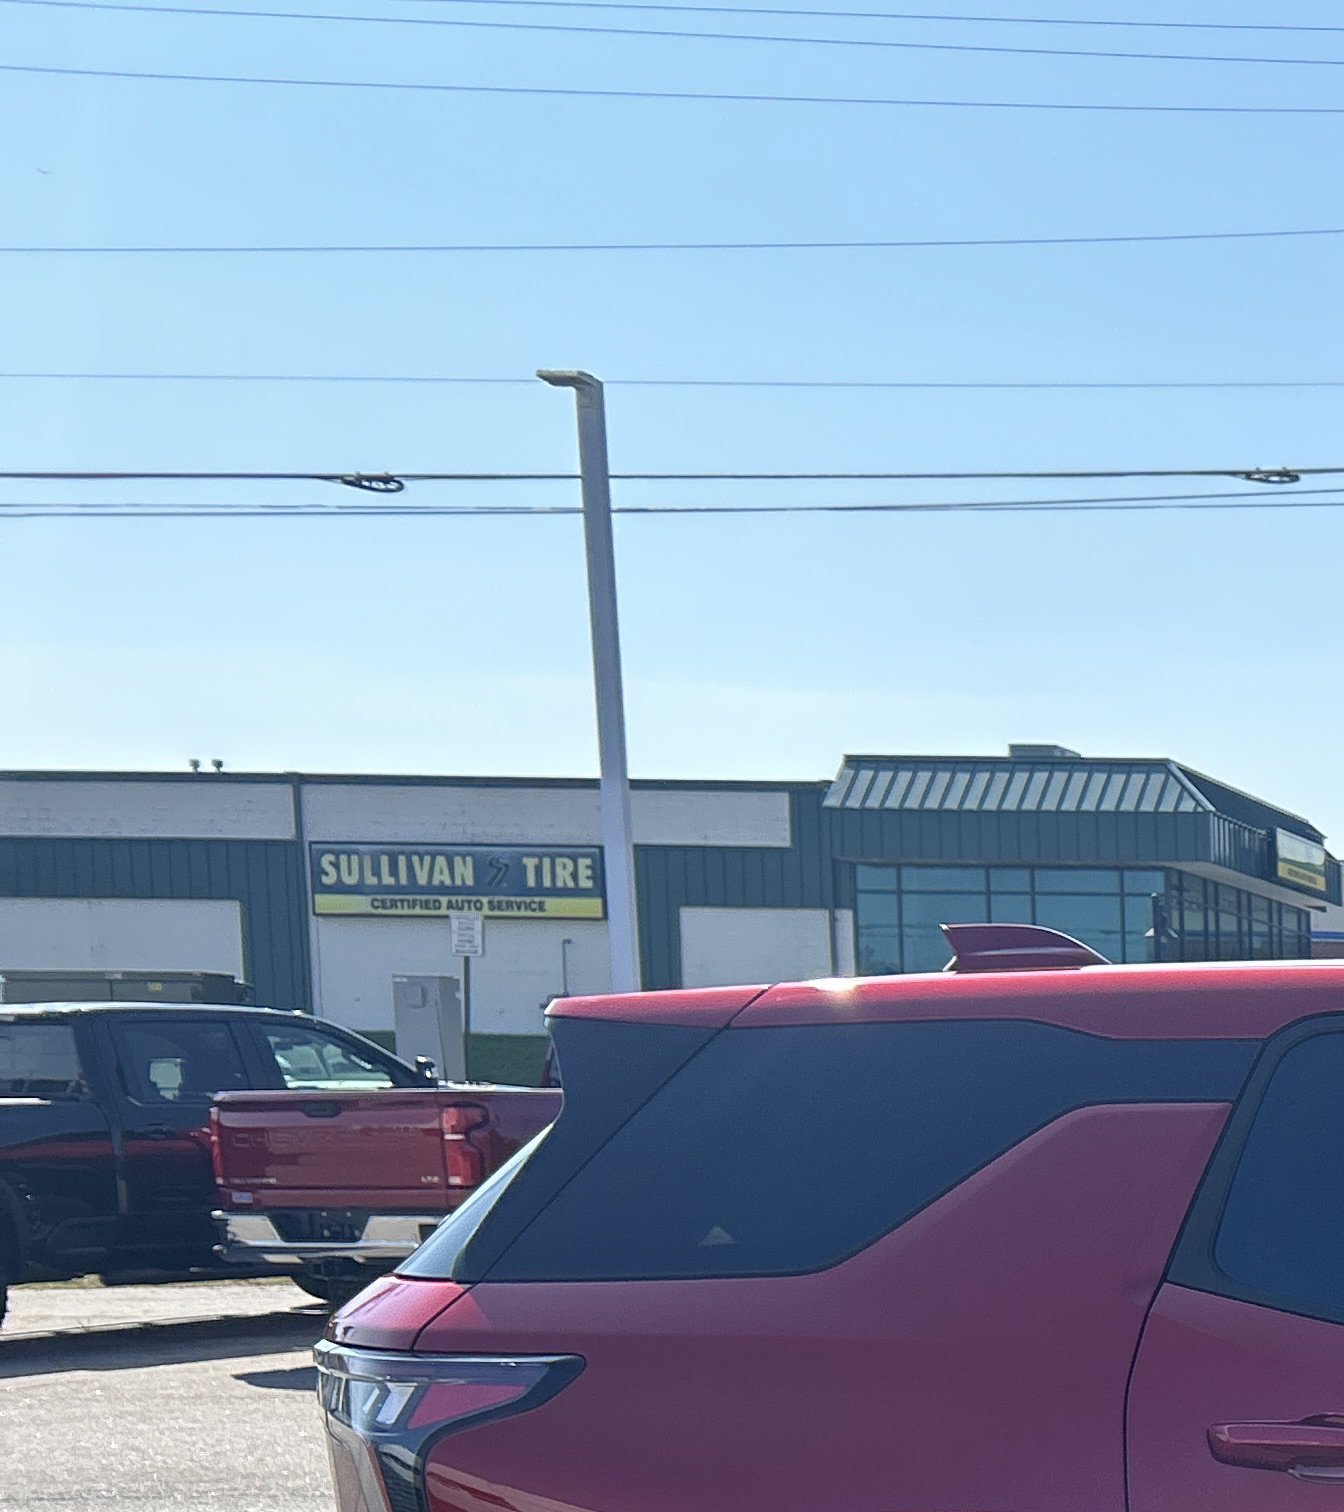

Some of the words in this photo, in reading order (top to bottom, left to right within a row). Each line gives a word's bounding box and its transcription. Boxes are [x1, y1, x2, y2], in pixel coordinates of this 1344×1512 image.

[320, 853, 474, 886] SULLIVAN
[522, 855, 593, 889] TIRE
[370, 897, 442, 911] CERTIFIED
[446, 898, 484, 911] AUTO
[487, 899, 546, 912] SERVICE
